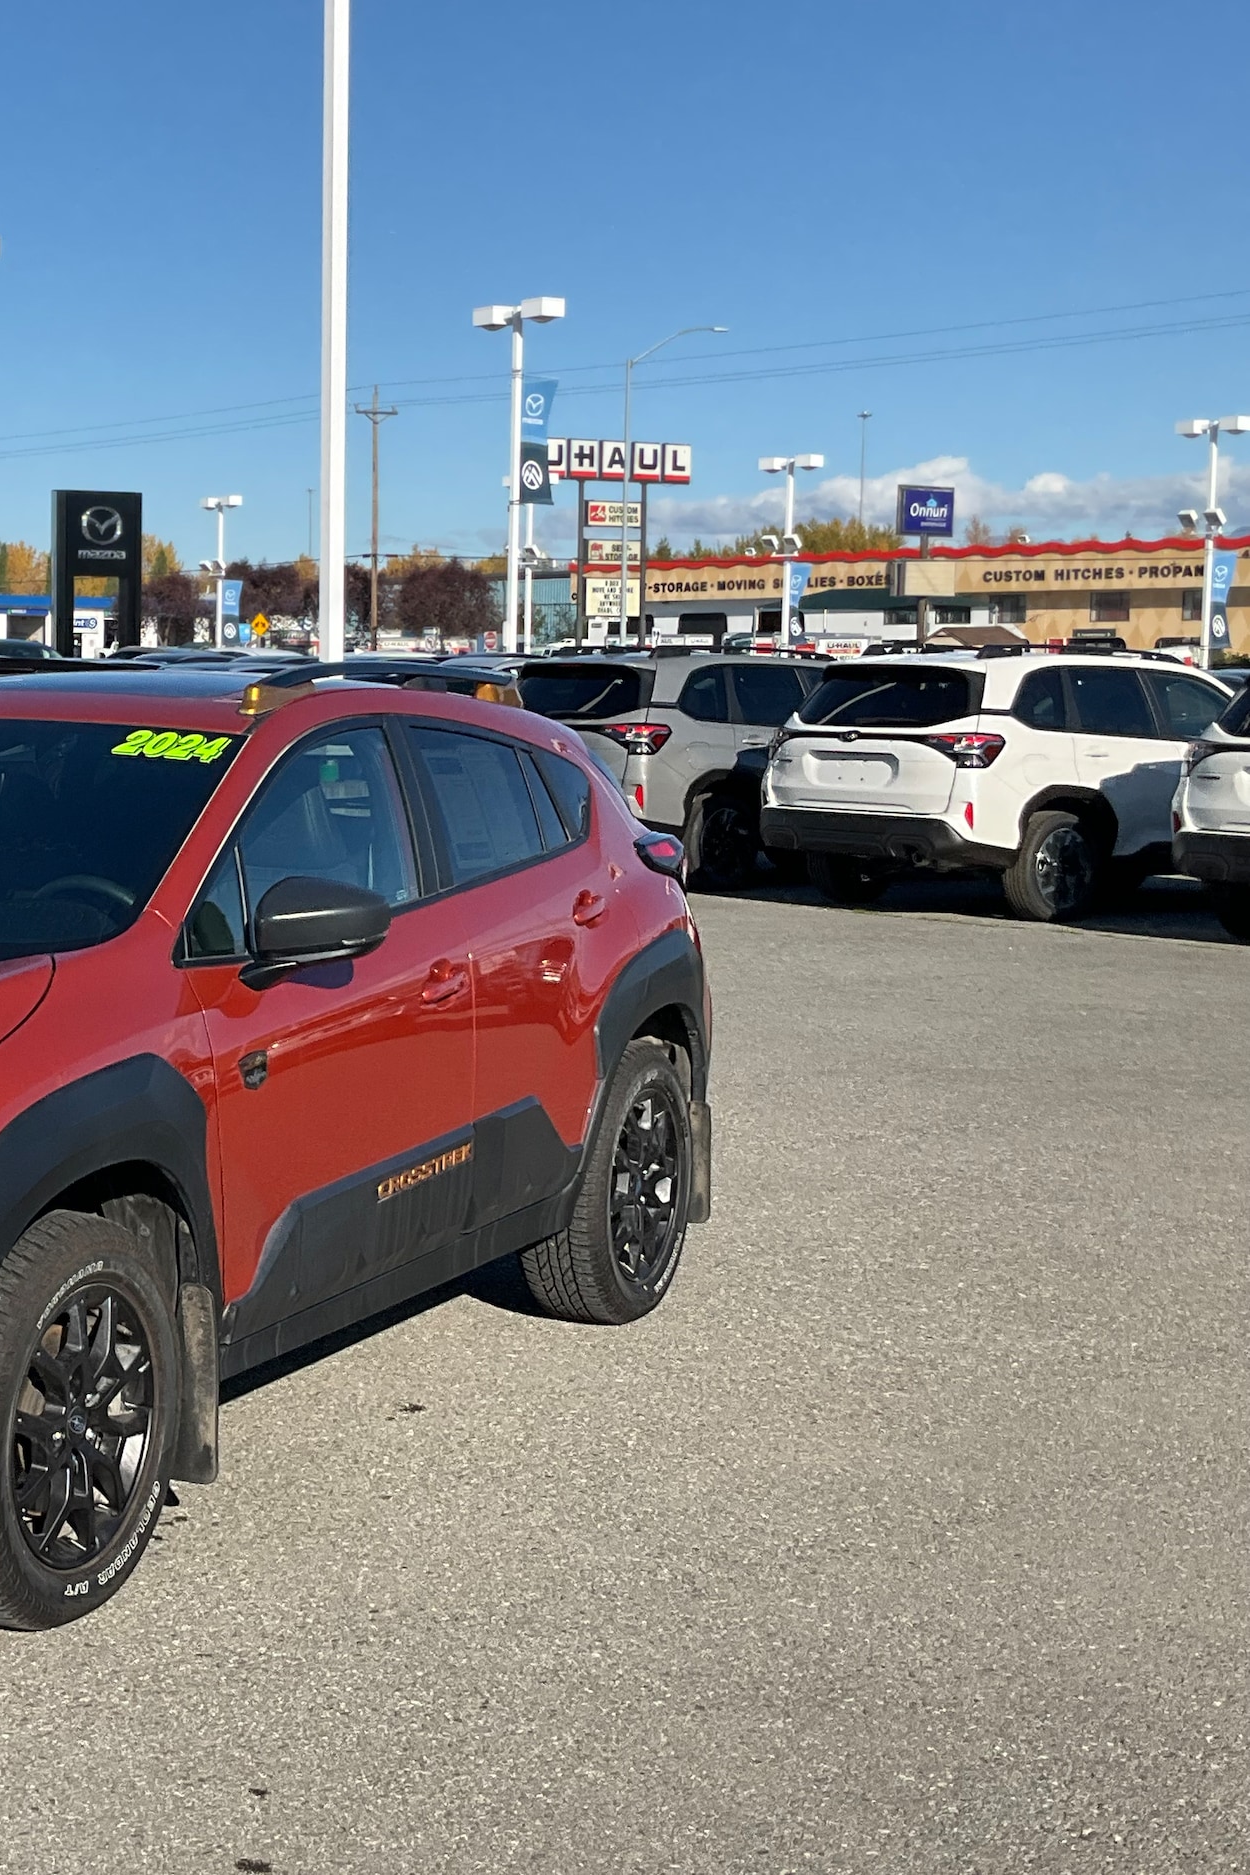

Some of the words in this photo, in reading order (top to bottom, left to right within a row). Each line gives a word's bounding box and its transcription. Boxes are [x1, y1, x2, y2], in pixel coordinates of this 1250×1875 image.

[609, 506, 638, 514] CUSOM
[910, 503, 948, 518] Onnuri
[605, 553, 638, 561] STORGE
[983, 569, 1045, 583] CUSTOM
[1054, 567, 1124, 581] HITCHES
[1138, 565, 1204, 578] PROPAN
[717, 579, 766, 591] MOVING
[111, 729, 232, 763] 2024
[377, 1141, 474, 1201] CROSSTREK
[97, 1480, 161, 1586] GEOLANDAR
[64, 1581, 89, 1596] A/T
